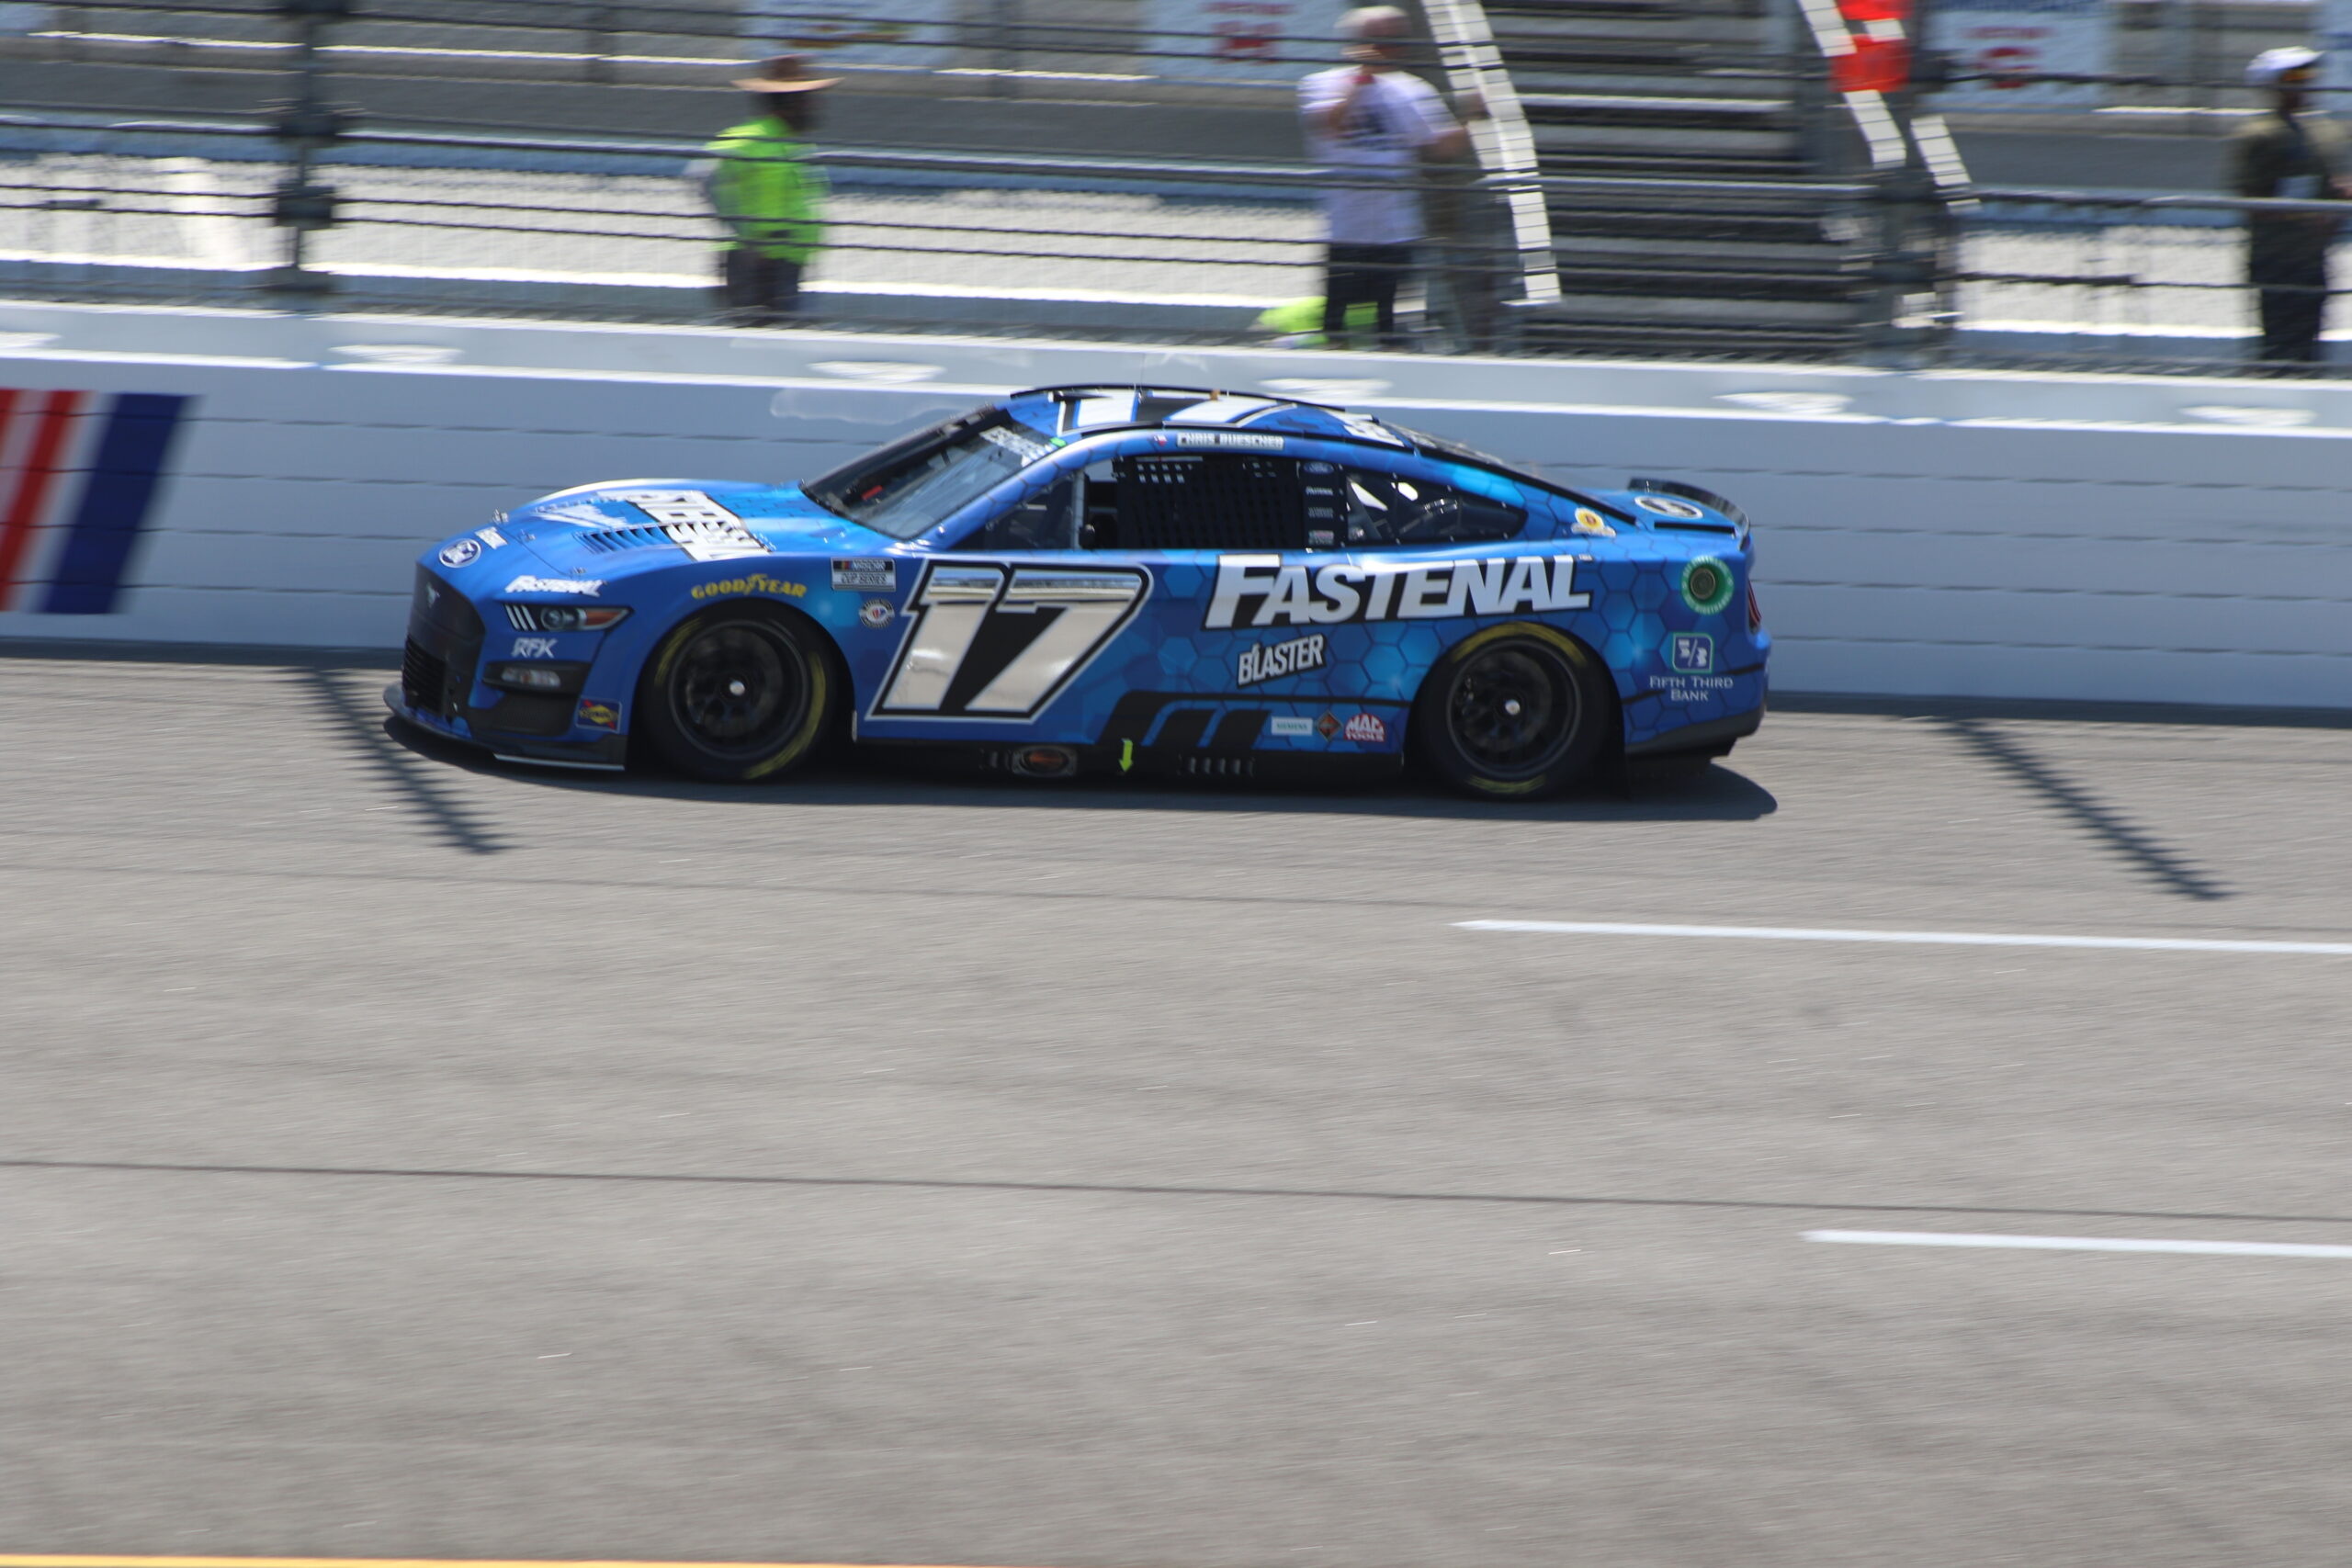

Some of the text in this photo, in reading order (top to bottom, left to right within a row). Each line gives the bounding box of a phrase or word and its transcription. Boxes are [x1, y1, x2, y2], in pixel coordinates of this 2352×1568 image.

[691, 573, 808, 599] GOODYEAR
[1204, 554, 1591, 627] FASTENAL
[511, 637, 558, 659] RFK
[869, 557, 1151, 720] 17
